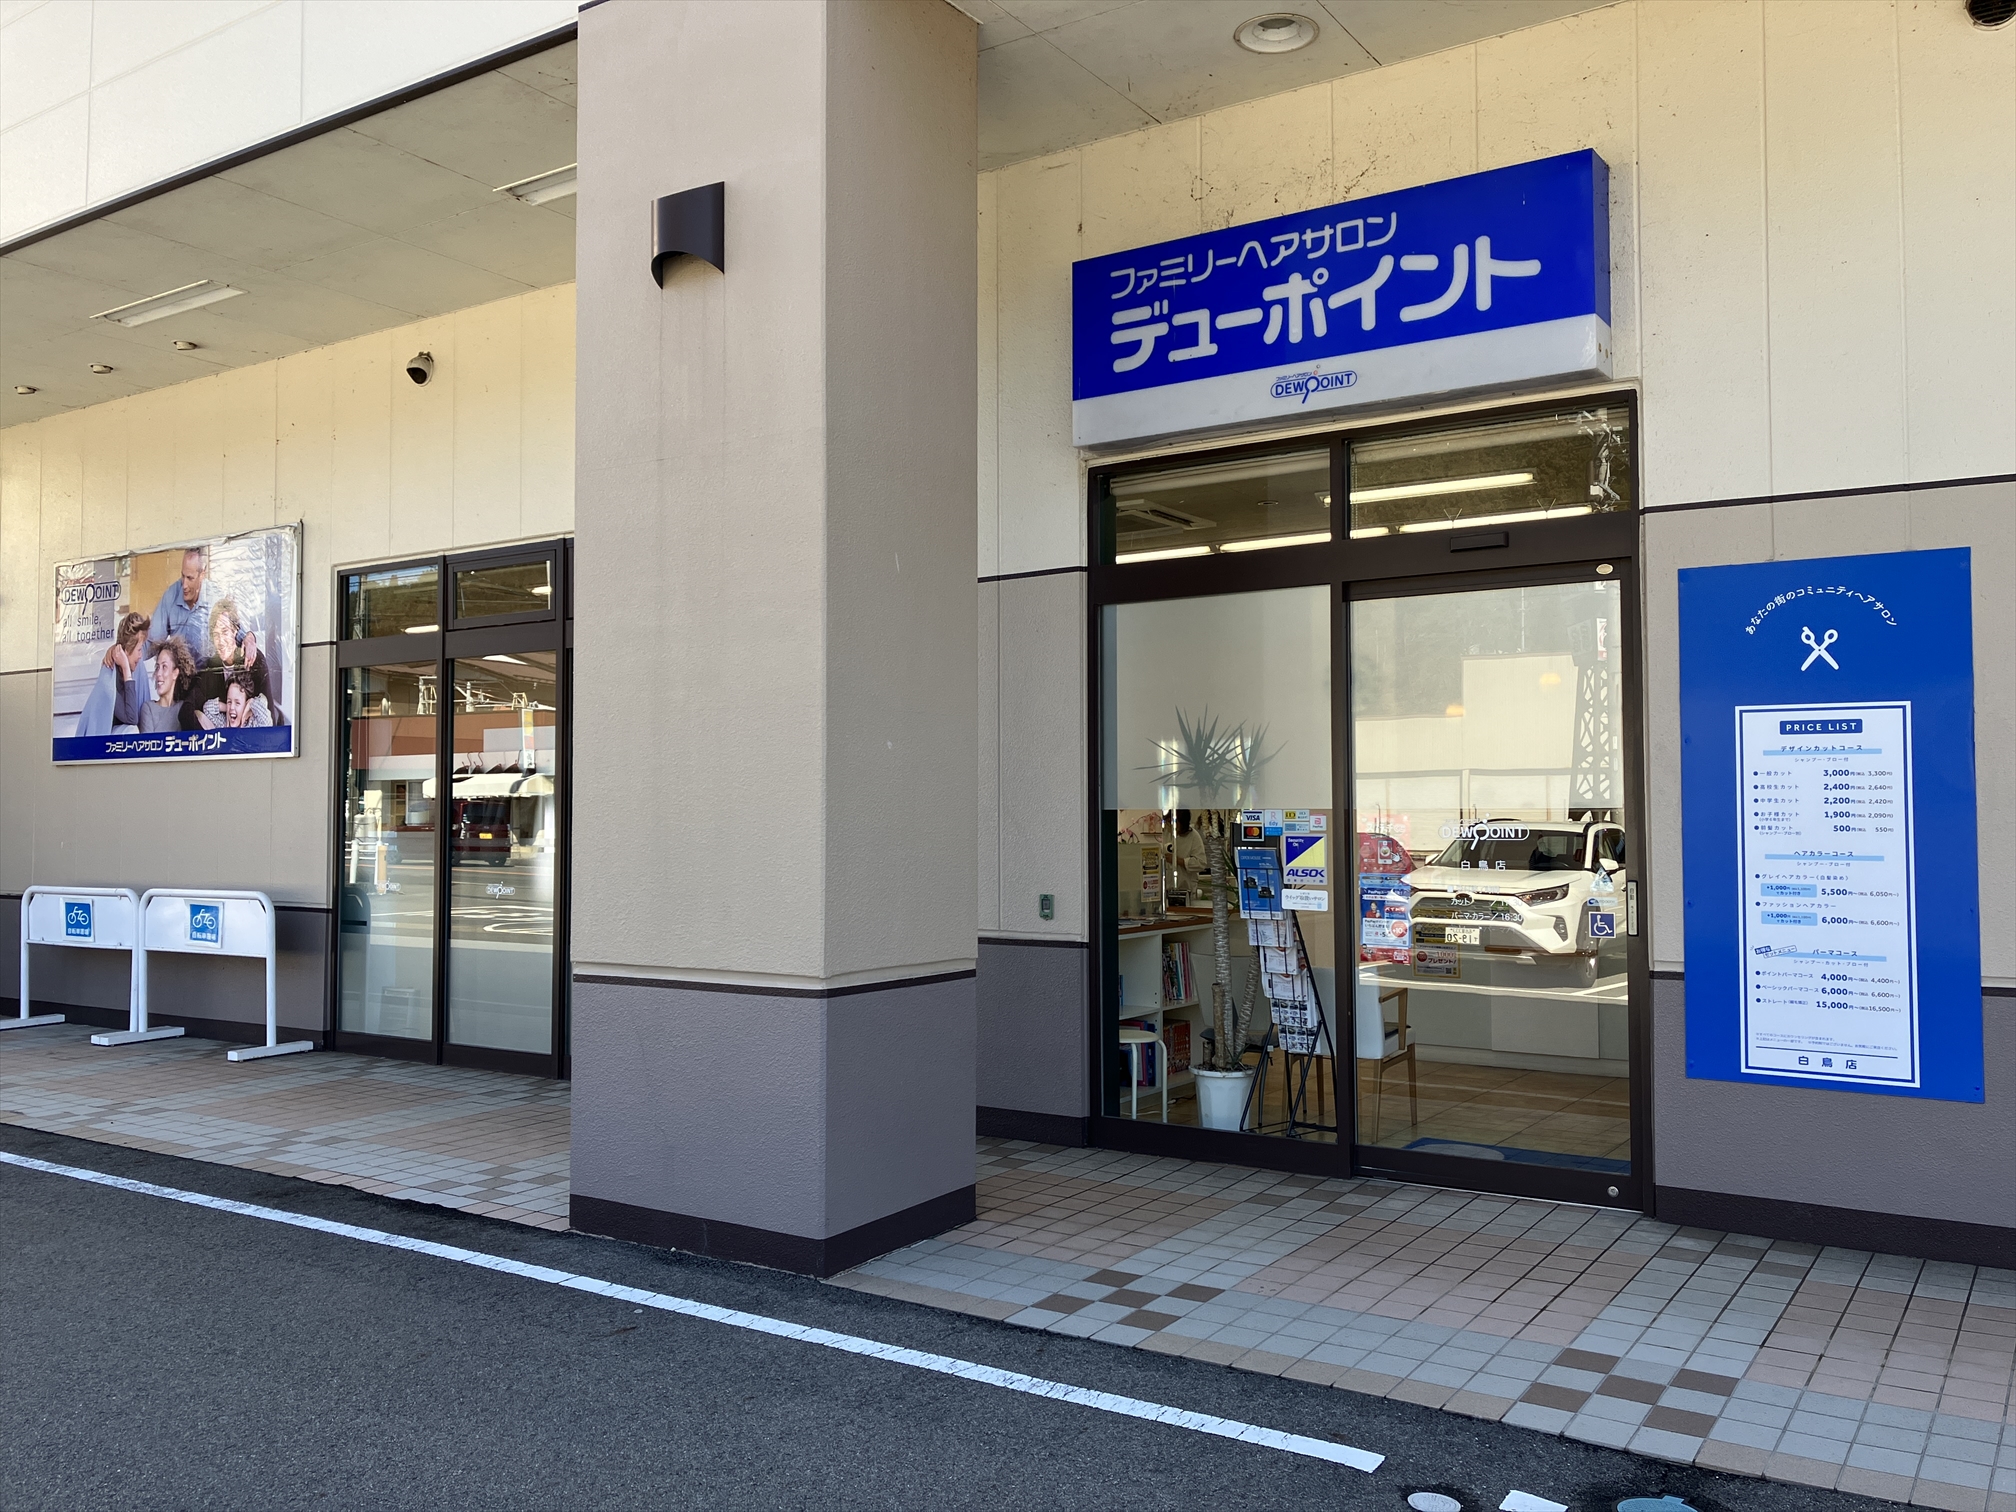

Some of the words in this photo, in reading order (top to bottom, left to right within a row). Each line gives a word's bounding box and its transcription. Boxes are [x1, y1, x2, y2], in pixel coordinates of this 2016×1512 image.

[1110, 211, 1397, 300] ファミリーヘアサロン
[1110, 235, 1541, 373] デューポイント
[1274, 372, 1354, 404] DEWPOINT
[64, 583, 119, 615] DEWPOINT
[77, 613, 102, 626] smile,
[1745, 586, 1897, 634] あなたの街のコミュニティヘアサロン
[77, 627, 115, 644] together
[1786, 723, 1822, 731] PRICE
[1828, 723, 1857, 731] LIST
[105, 739, 163, 753] ファミリーヘアサロン
[165, 731, 227, 753] デューポイント
[1286, 868, 1325, 877] ALSOK
[1812, 949, 1858, 957] パーマコース
[1798, 1056, 1857, 1070] 白鳥店
